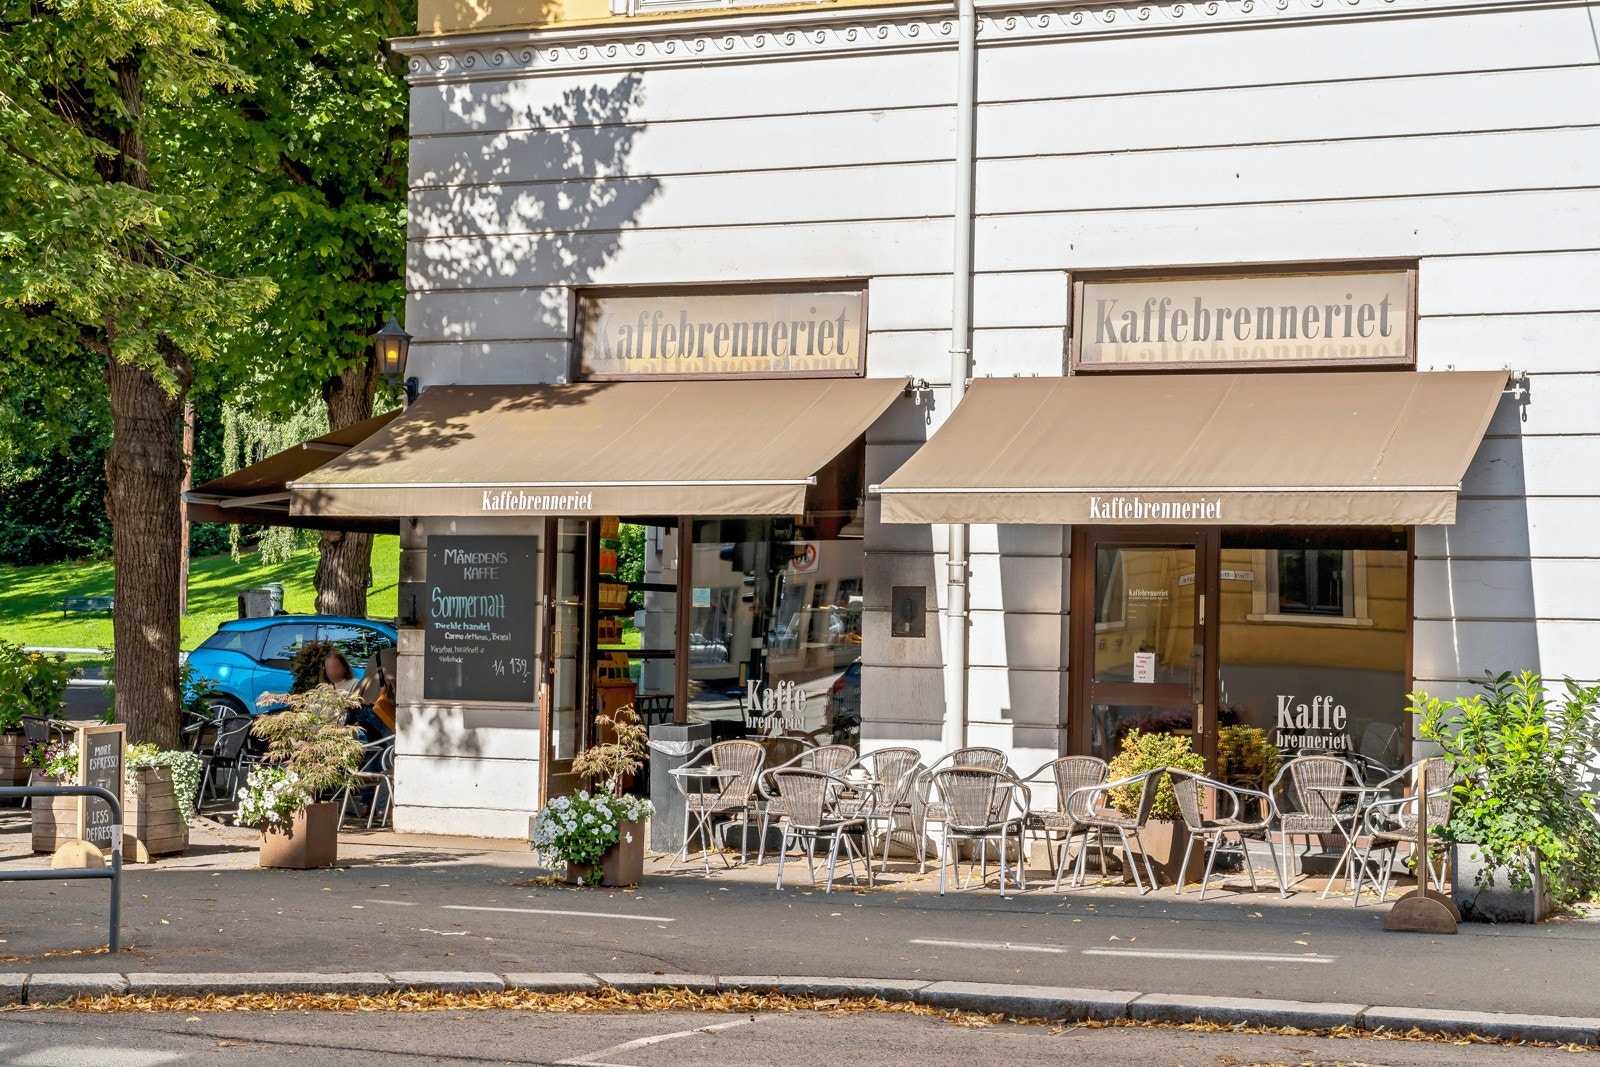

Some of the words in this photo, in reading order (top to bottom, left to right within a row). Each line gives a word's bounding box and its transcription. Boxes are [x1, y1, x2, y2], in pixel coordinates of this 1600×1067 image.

[1094, 292, 1393, 345] Kaffebrenneriet
[591, 305, 850, 361] Kaffebrenneriet
[482, 490, 593, 511] Kaffebrenneriet
[1089, 496, 1222, 519] Kaffebrenneriet
[444, 548, 507, 565] MÅNEDENS
[464, 566, 499, 580] KAFFE
[431, 586, 506, 618] Sommernatt
[463, 622, 491, 631] handel
[491, 632, 511, 641] Brasil
[746, 680, 806, 712] Kaffe
[745, 713, 806, 730] brenneriet
[1276, 695, 1347, 730] Kaffe
[1276, 730, 1347, 749] brenneriet
[94, 744, 112, 756] MORE
[89, 755, 118, 770] ESPRESSO
[92, 809, 109, 824] LESS
